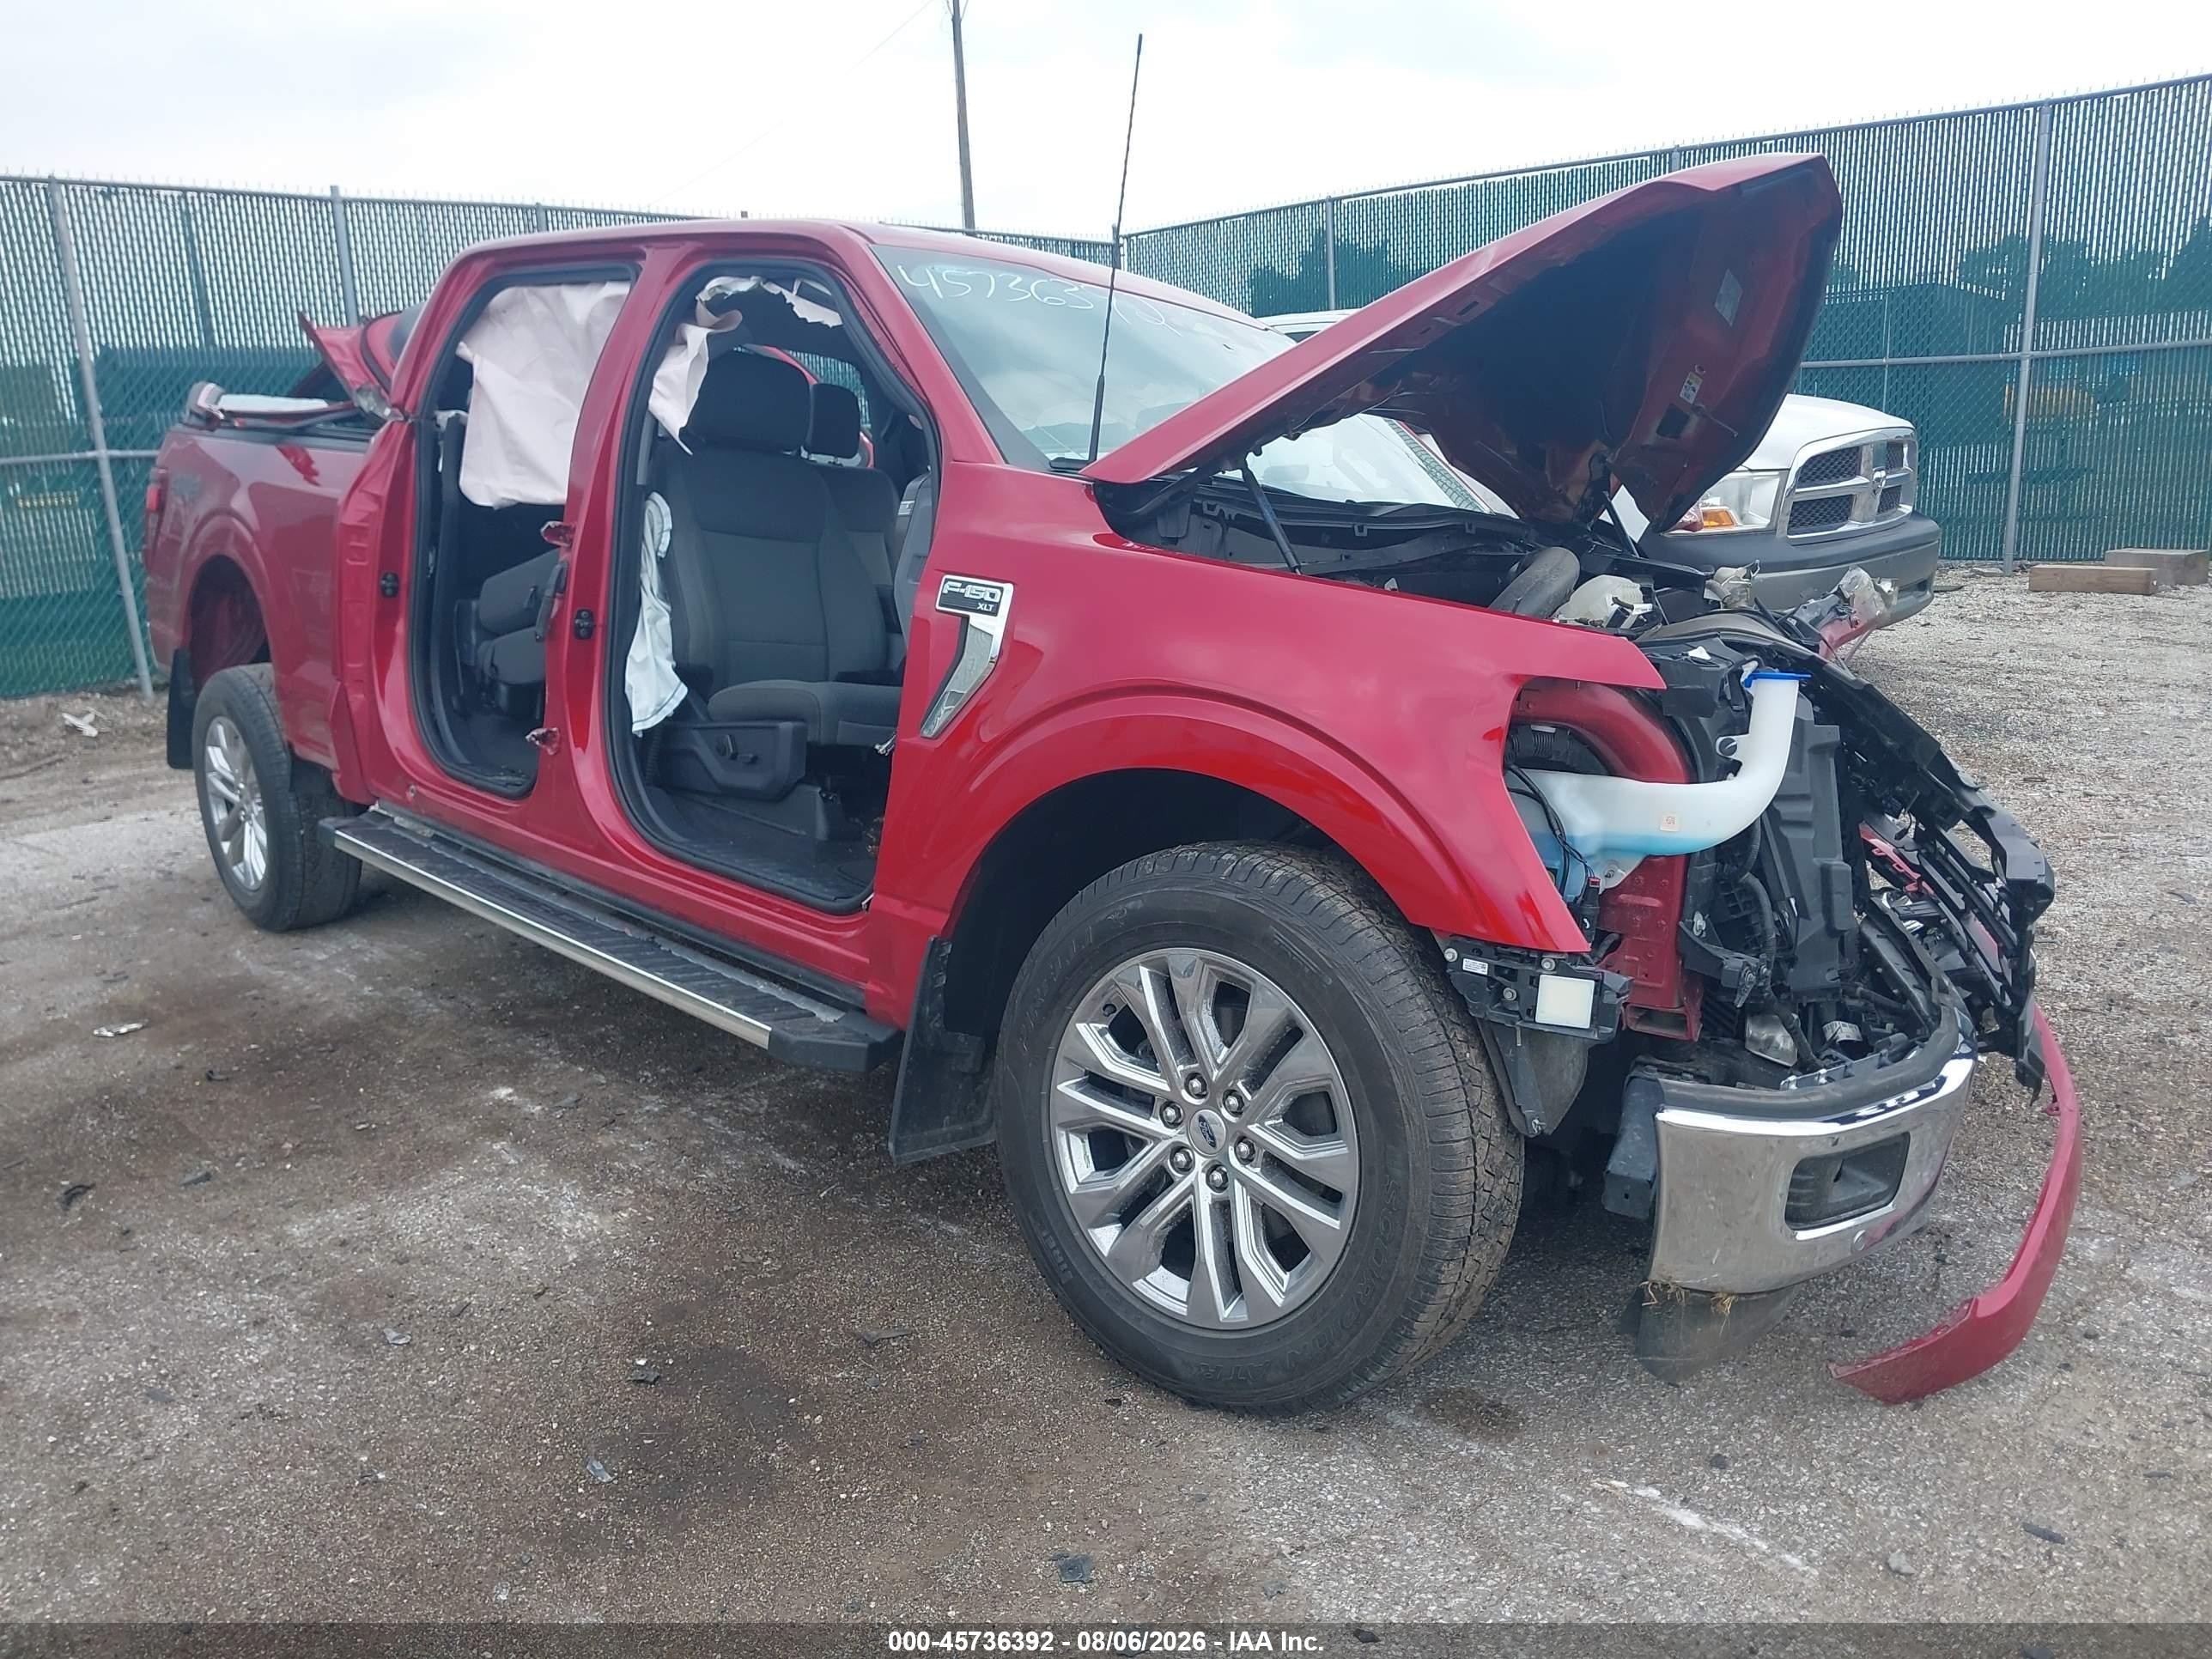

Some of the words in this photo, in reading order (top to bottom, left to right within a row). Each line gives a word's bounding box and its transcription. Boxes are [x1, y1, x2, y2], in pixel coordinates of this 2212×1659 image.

[942, 580, 1002, 603] F-150
[976, 602, 994, 612] XLT
[1285, 1173, 1403, 1369] SCORPION
